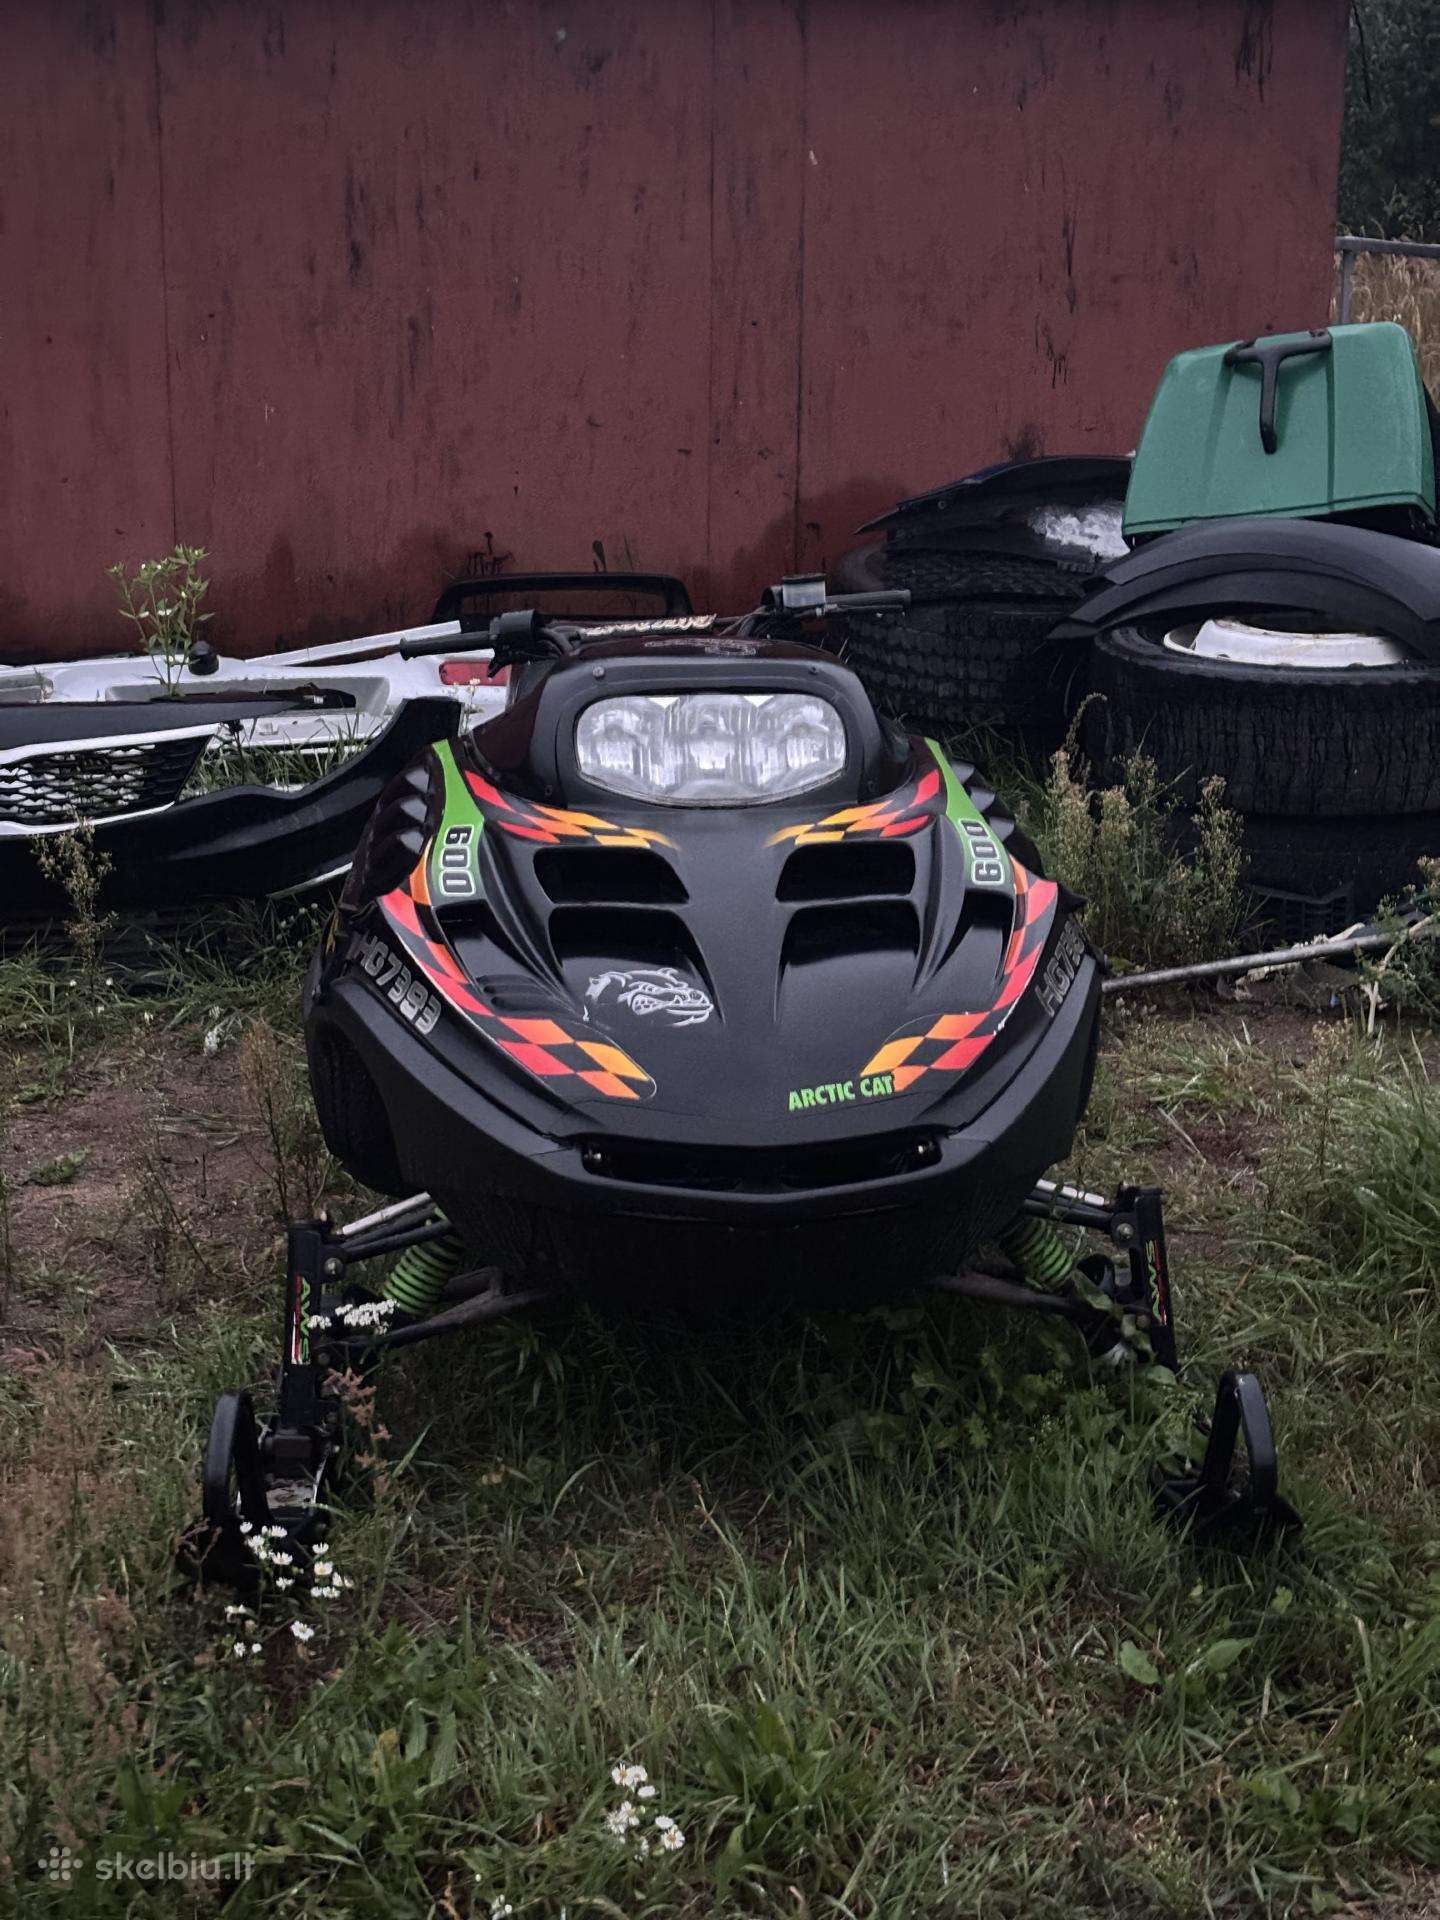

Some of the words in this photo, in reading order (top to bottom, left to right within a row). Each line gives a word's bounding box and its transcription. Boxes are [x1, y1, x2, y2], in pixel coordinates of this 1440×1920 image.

[439, 824, 476, 897] 600
[958, 818, 1006, 886] 600
[788, 1081, 856, 1112] ARCTIC
[860, 1075, 893, 1097] CAT
